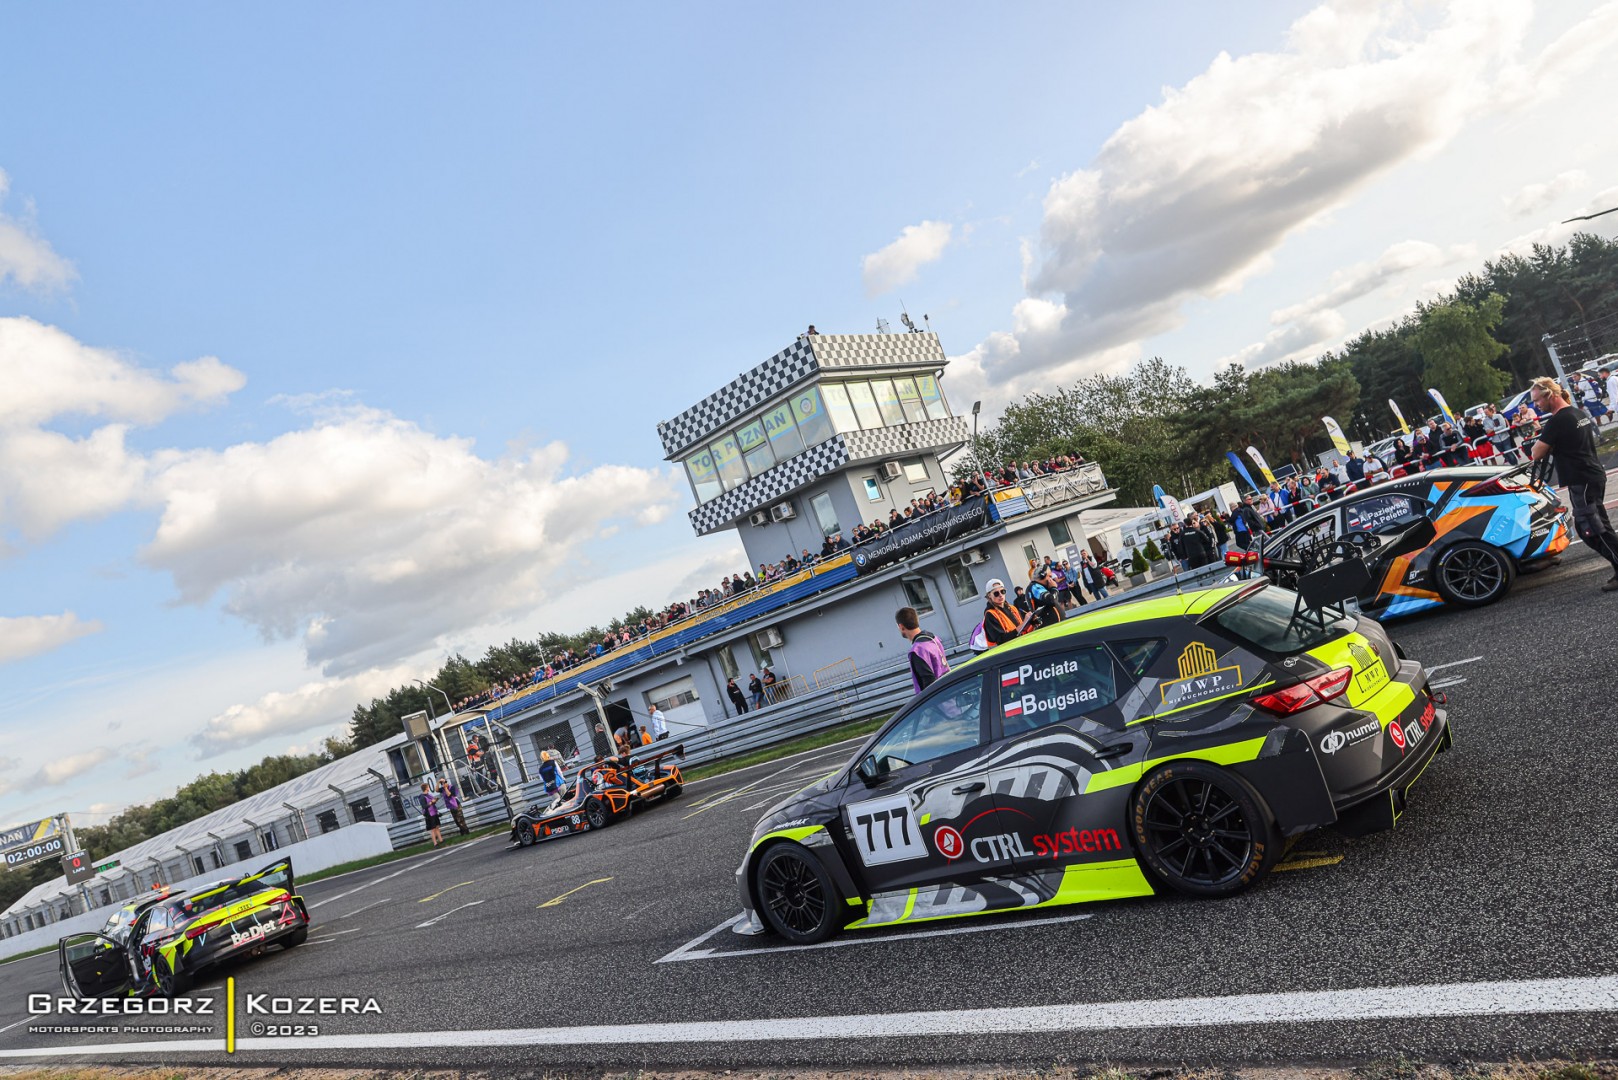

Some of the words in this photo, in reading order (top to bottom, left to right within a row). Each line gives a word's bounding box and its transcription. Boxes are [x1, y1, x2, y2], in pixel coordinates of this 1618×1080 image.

[900, 532, 924, 547] ADAMA
[1019, 660, 1078, 685] Puciata
[1021, 687, 1098, 715] Bougsiaa
[1404, 718, 1425, 748] CTRL
[856, 806, 911, 853] 777
[7, 840, 61, 864] 02:00:00
[65, 851, 85, 861] LEADER
[970, 831, 1034, 864] CTRL
[1032, 825, 1122, 861] system
[72, 857, 81, 868] 0
[72, 866, 86, 874] LAPS
